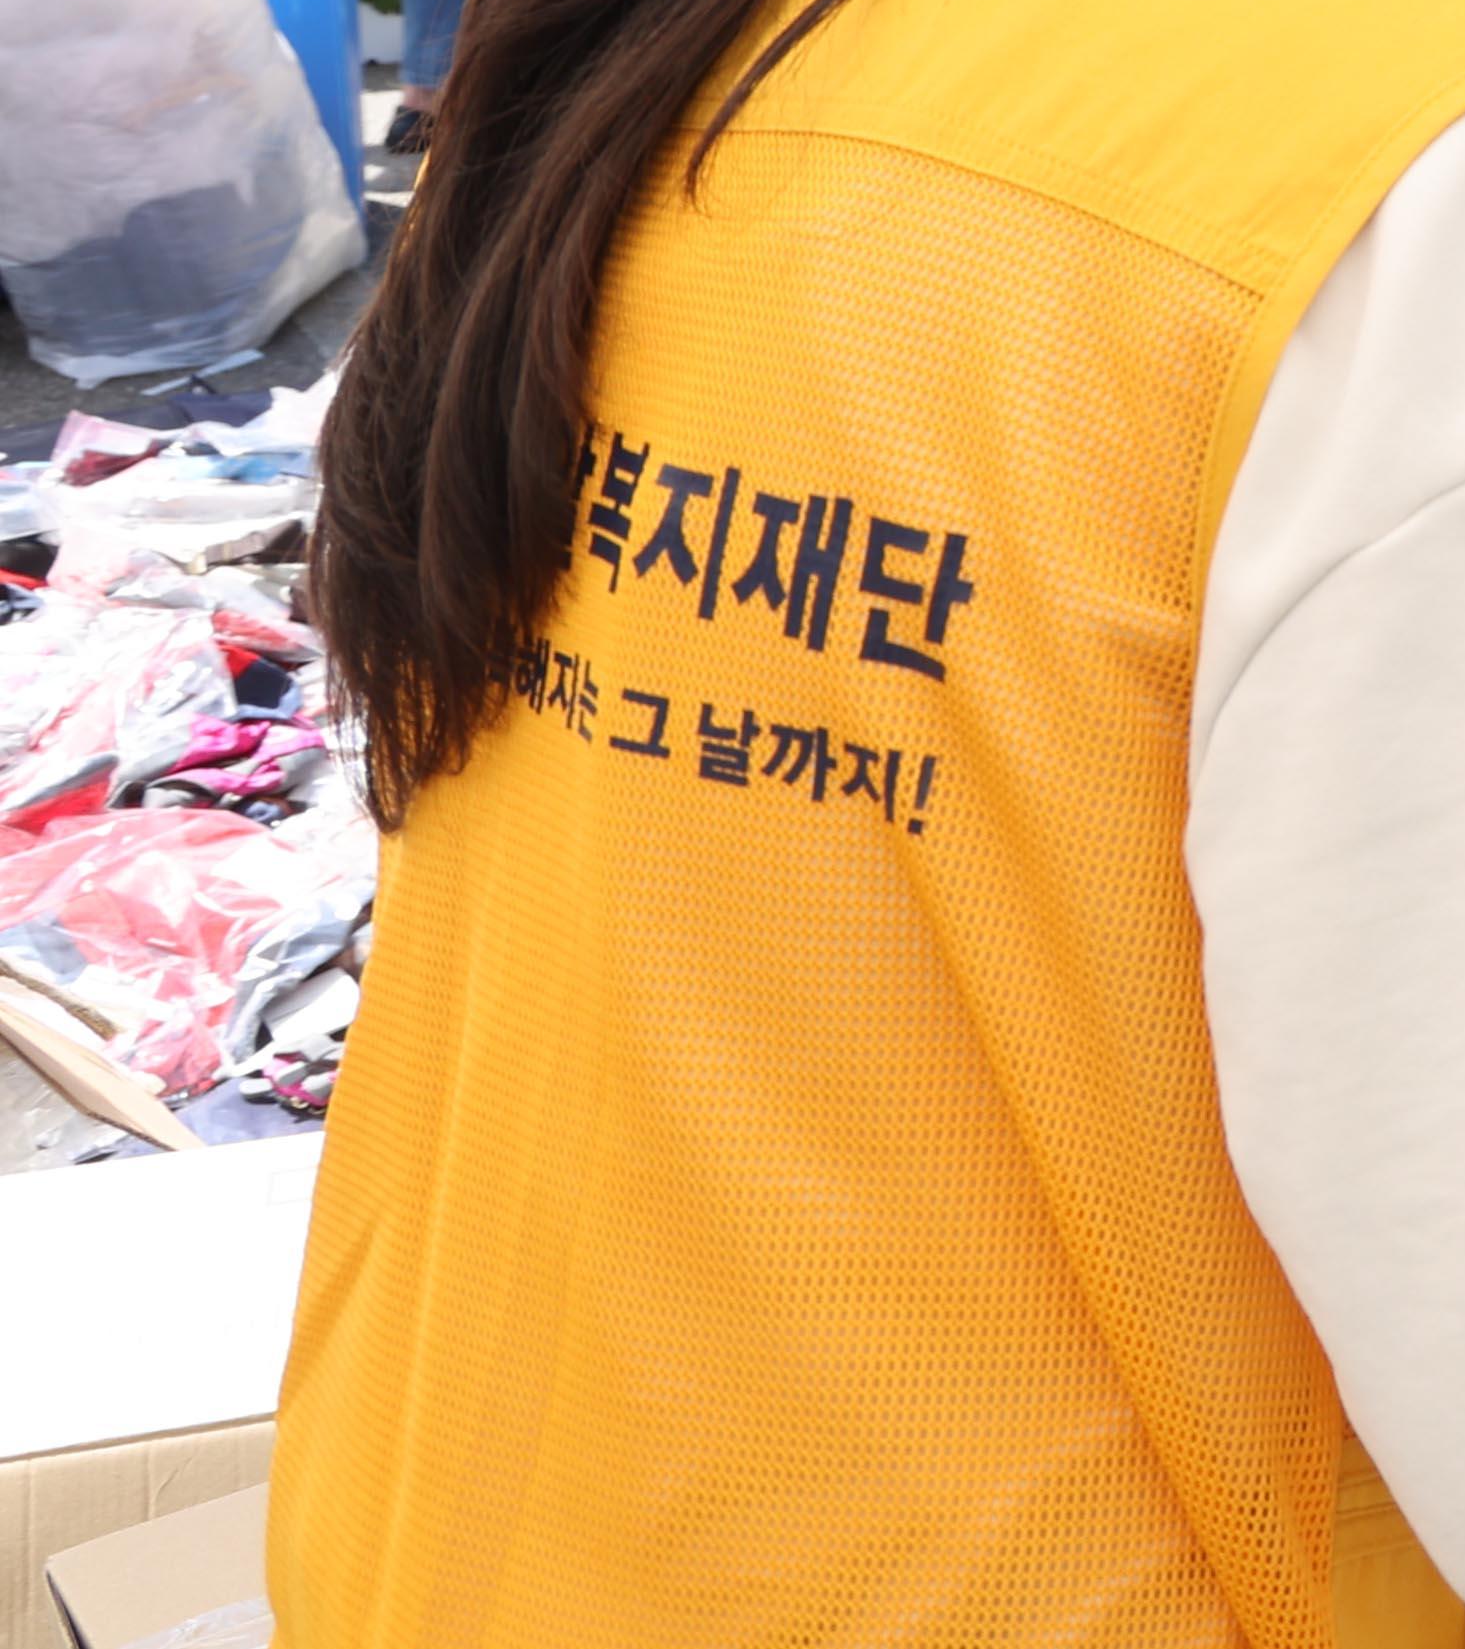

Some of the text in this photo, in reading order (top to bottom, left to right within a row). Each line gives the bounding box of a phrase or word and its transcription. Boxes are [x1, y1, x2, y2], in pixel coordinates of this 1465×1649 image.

[488, 637, 938, 836] 해지는 그 날까지!
